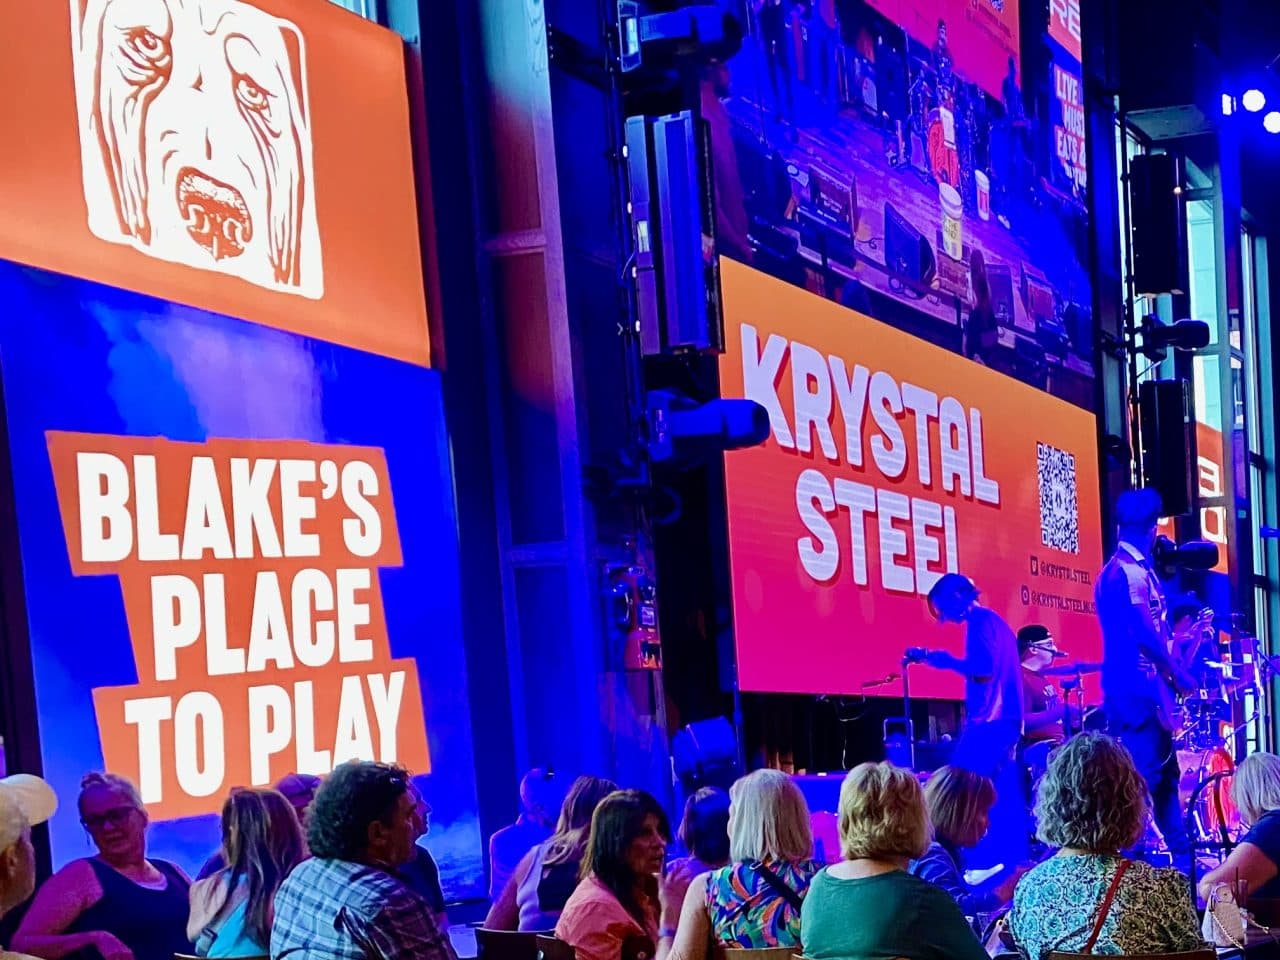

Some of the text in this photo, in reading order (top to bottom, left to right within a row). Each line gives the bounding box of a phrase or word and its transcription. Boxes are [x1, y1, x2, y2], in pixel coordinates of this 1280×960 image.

[1056, 69, 1079, 106] LIVE
[1057, 132, 1078, 163] EATS
[740, 322, 999, 504] KRYSTAL
[76, 451, 382, 563] BLAKE'S
[151, 568, 373, 682] PLACE
[124, 671, 406, 805] TO PLAY
